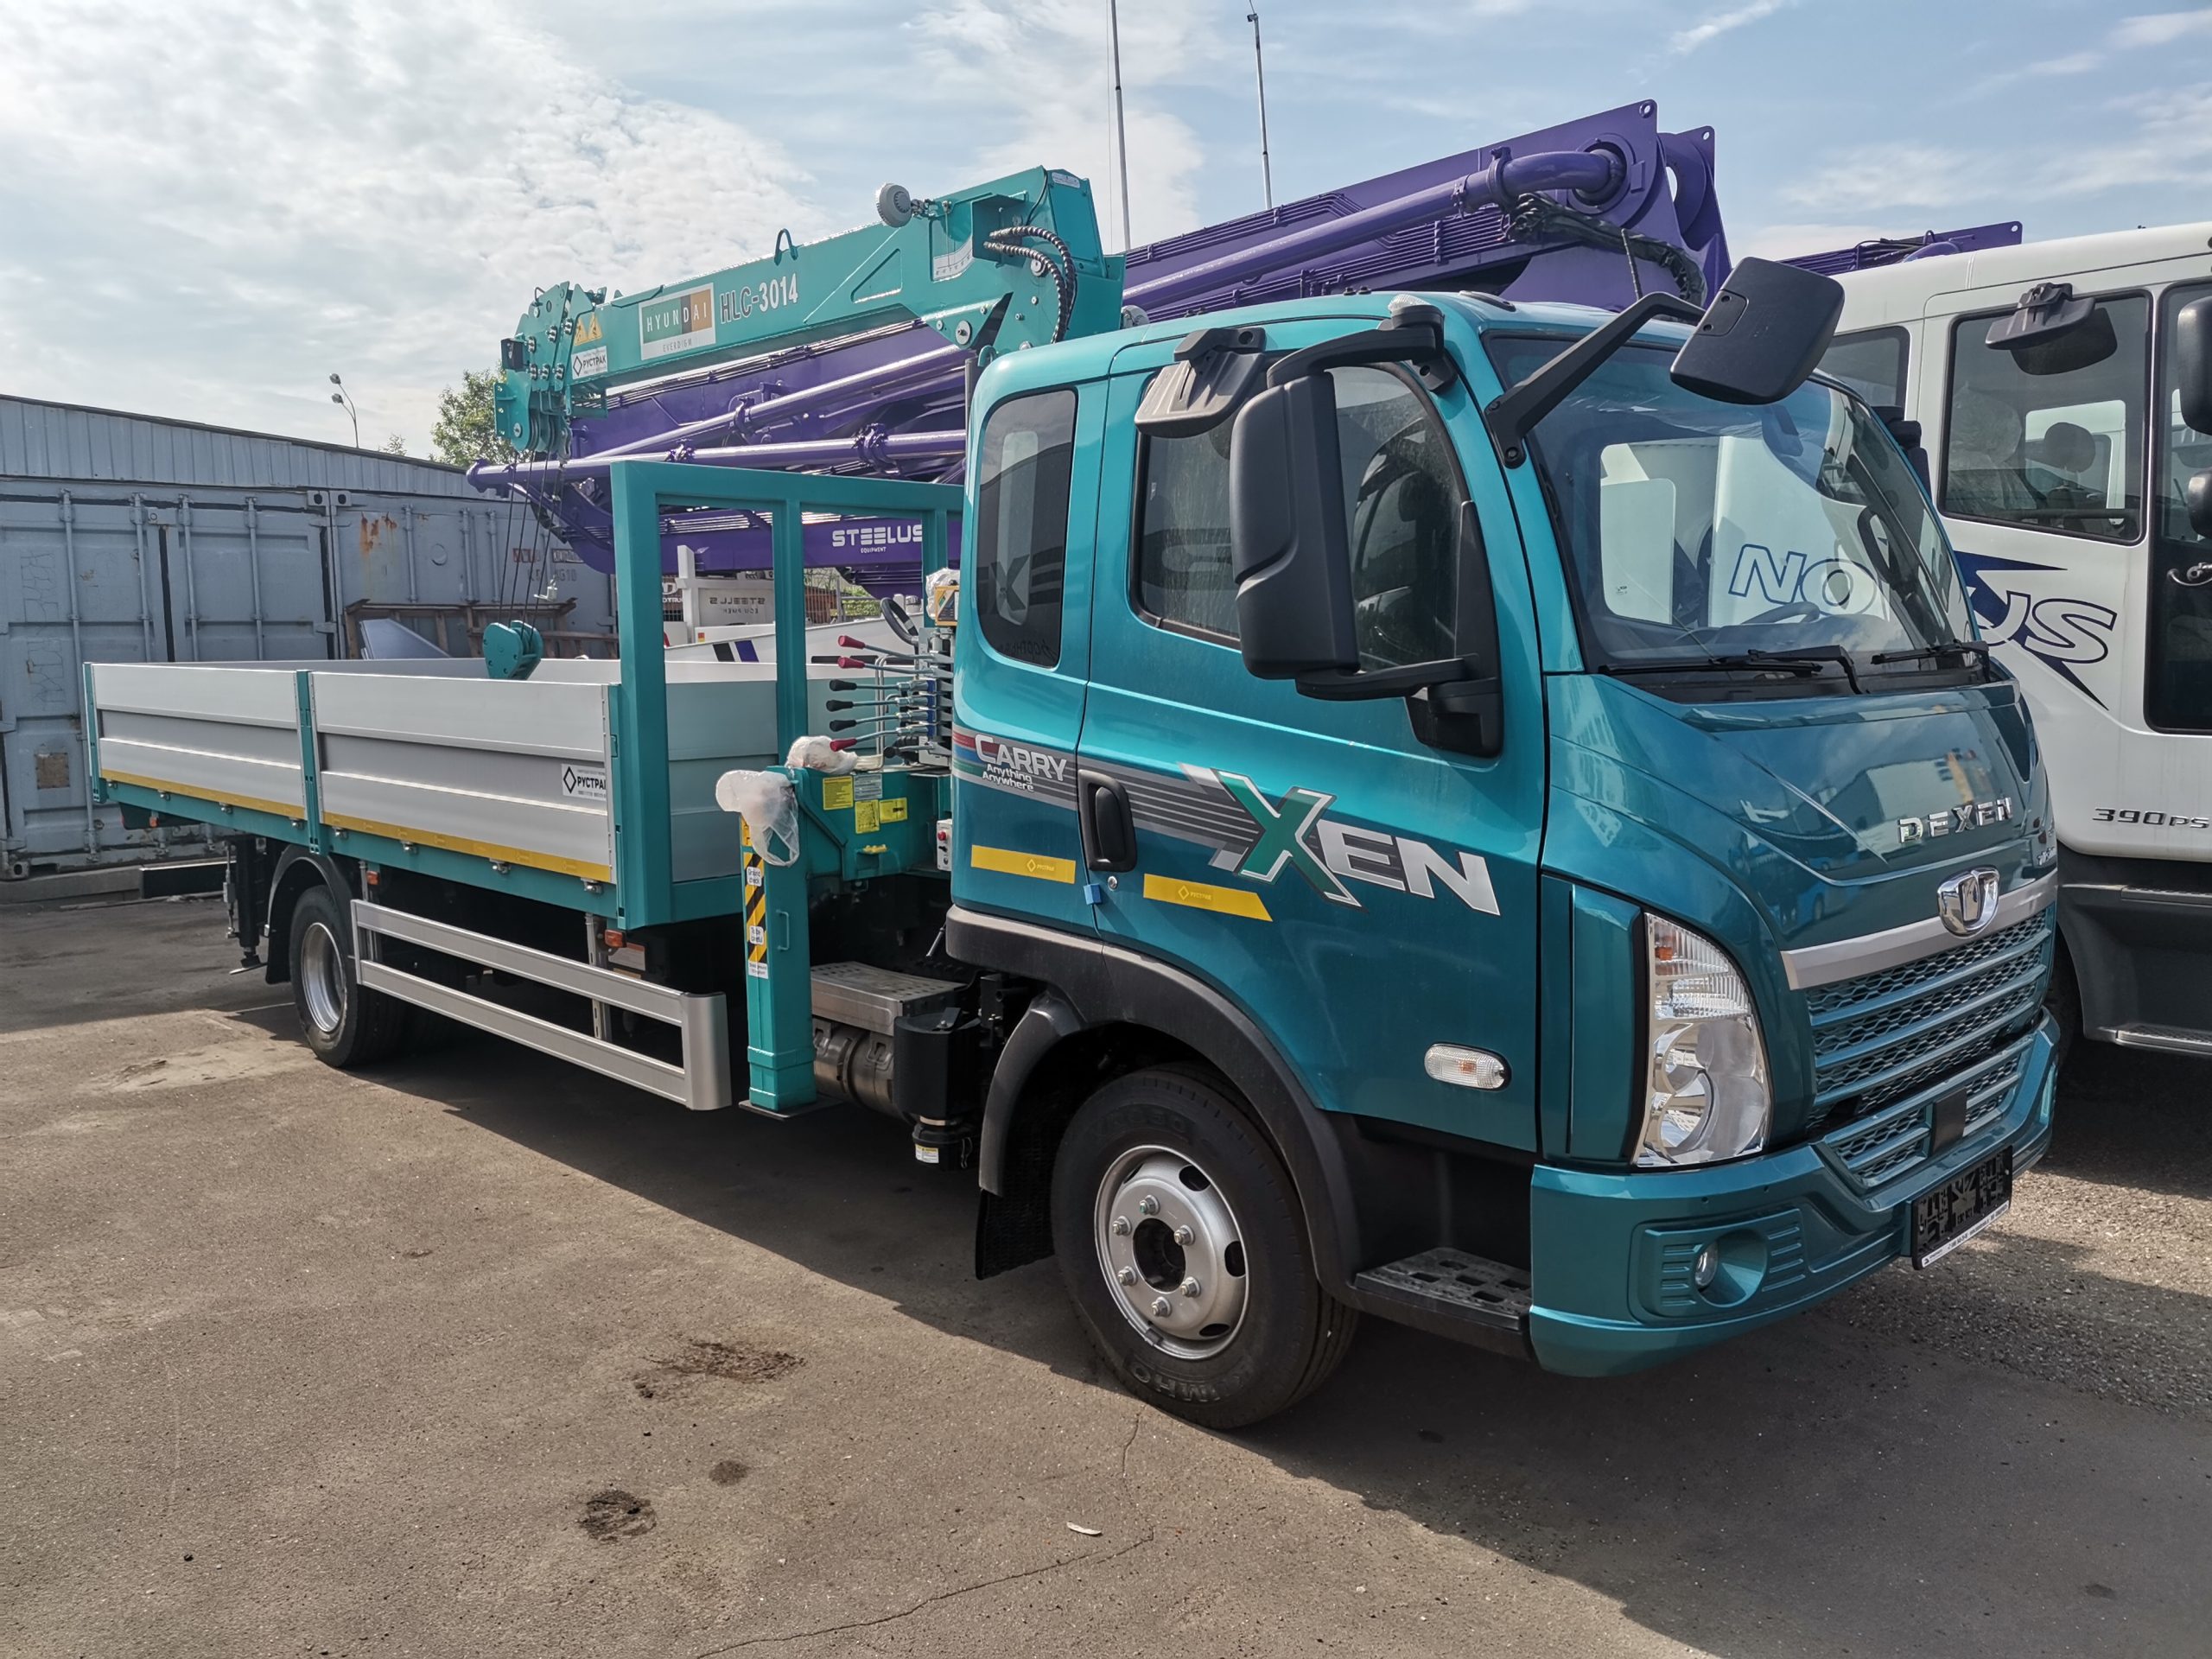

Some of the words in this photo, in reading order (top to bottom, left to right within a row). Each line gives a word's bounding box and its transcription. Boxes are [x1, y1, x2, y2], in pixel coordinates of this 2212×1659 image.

[645, 306, 709, 333] HYUNDAI
[719, 272, 799, 325] HLC-3014
[832, 524, 923, 547] STEELUS
[975, 734, 1067, 782] CARRY
[987, 763, 1033, 785] Anything
[982, 771, 1034, 792] Anywhere
[1210, 766, 1502, 917] XEN
[1899, 797, 2013, 843] DEXEN
[1132, 1358, 1251, 1403] UMHO
